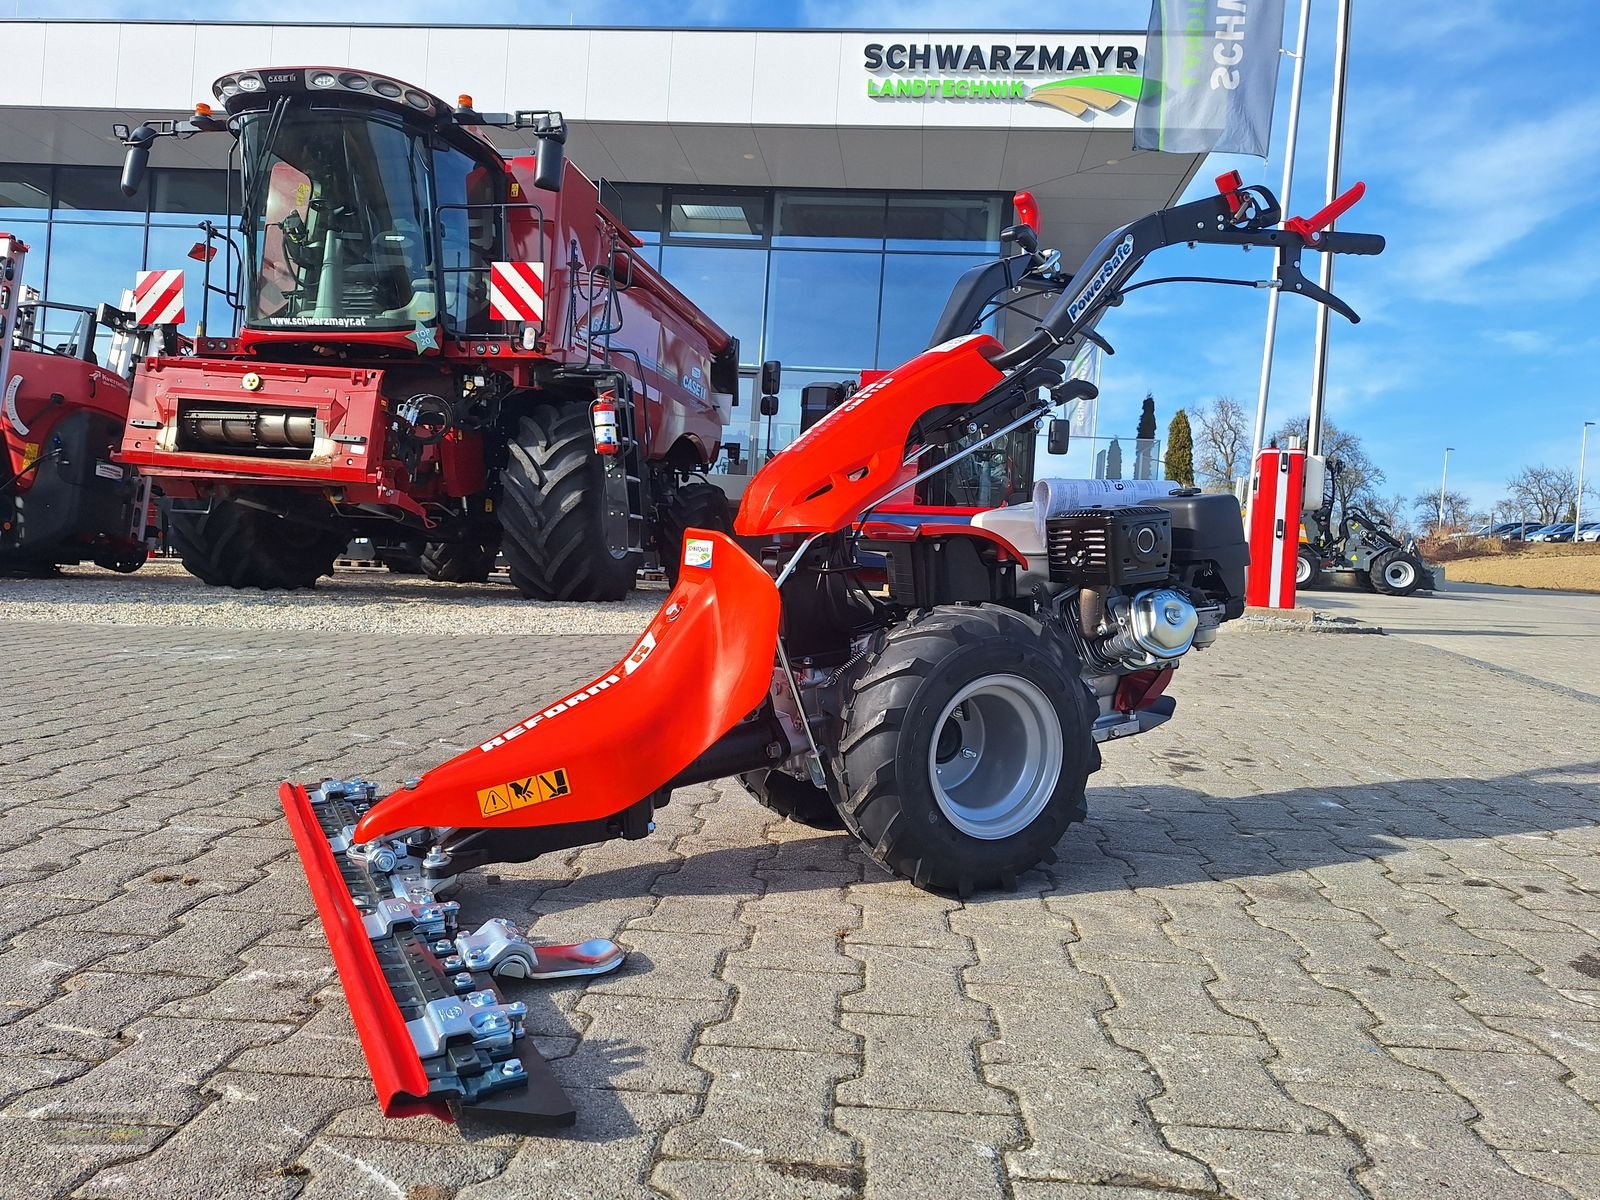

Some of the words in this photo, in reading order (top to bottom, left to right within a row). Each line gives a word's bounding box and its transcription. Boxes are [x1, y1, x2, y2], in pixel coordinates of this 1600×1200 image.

[864, 43, 1139, 72] SCHWARZMAYR
[268, 75, 288, 83] CASE
[867, 79, 1025, 98] LANDTECHNIK
[270, 316, 366, 328] www.schwarzmayr.at
[415, 329, 431, 338] TOP
[421, 338, 431, 346] 20
[683, 375, 701, 398] CASE
[479, 673, 621, 753] REFORM
